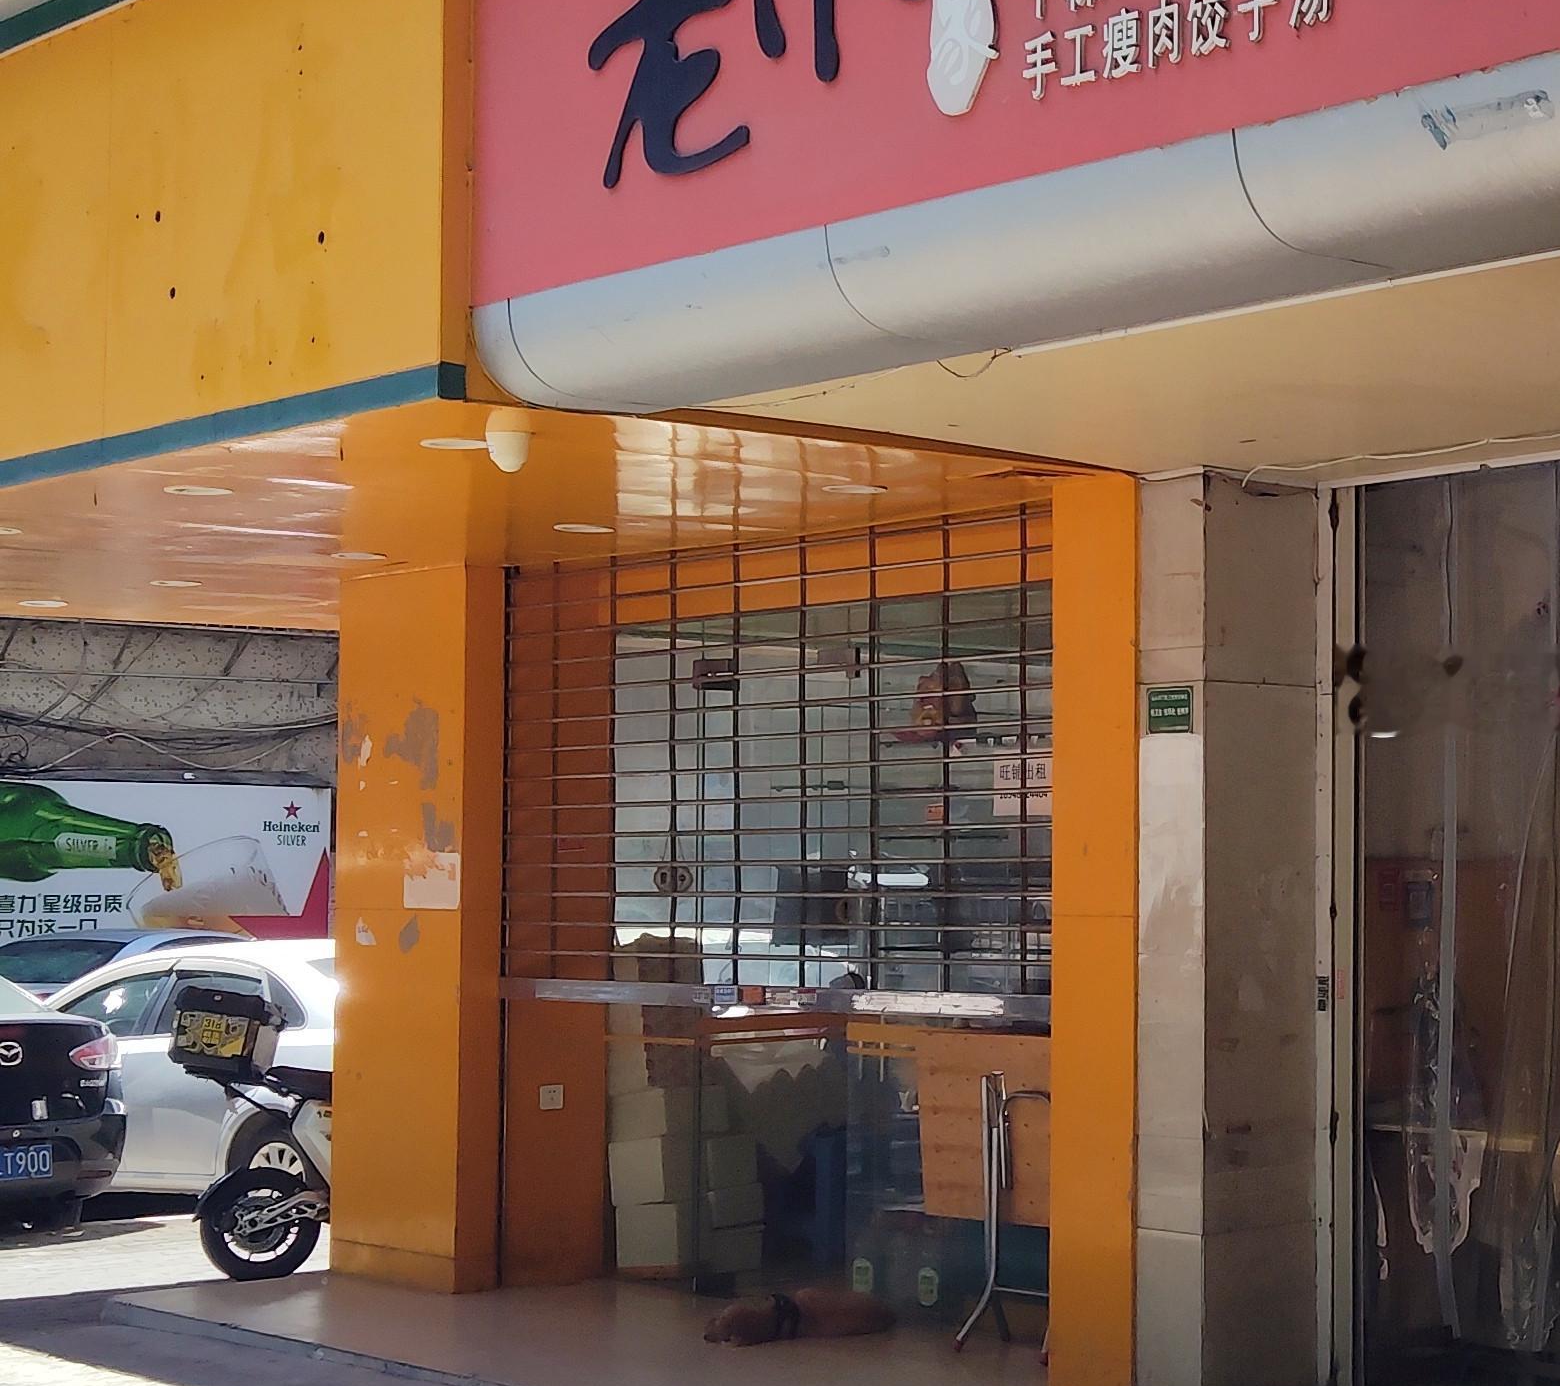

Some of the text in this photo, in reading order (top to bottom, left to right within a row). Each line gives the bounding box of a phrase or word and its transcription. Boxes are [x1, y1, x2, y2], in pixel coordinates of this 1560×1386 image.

[262, 821, 320, 833] Heineken
[277, 834, 307, 846] SILVER
[0, 1150, 50, 1175] T900
